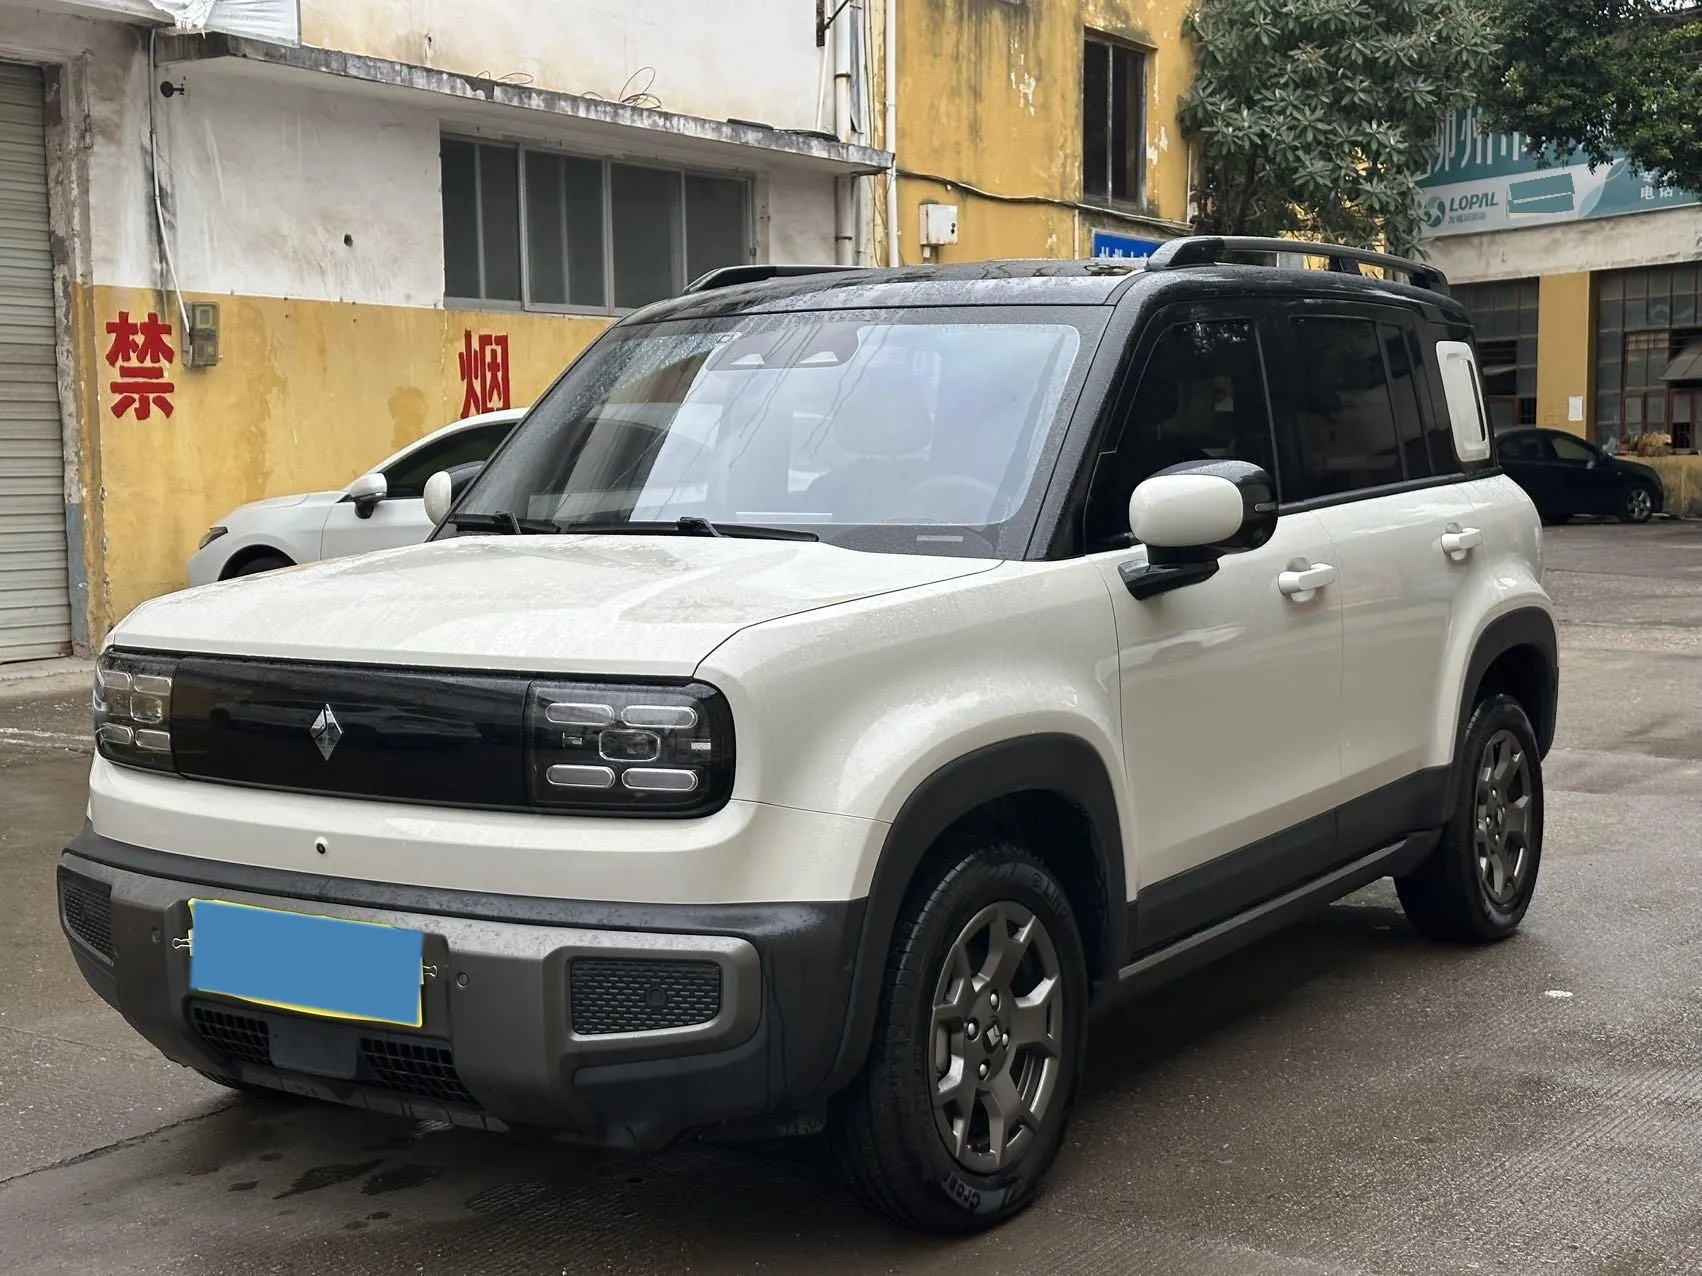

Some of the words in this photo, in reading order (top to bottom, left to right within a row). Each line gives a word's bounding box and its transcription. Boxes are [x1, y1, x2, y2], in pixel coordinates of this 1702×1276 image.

[1449, 191, 1499, 212] LOPAL
[105, 310, 175, 420] 禁
[458, 328, 511, 420] 烟
